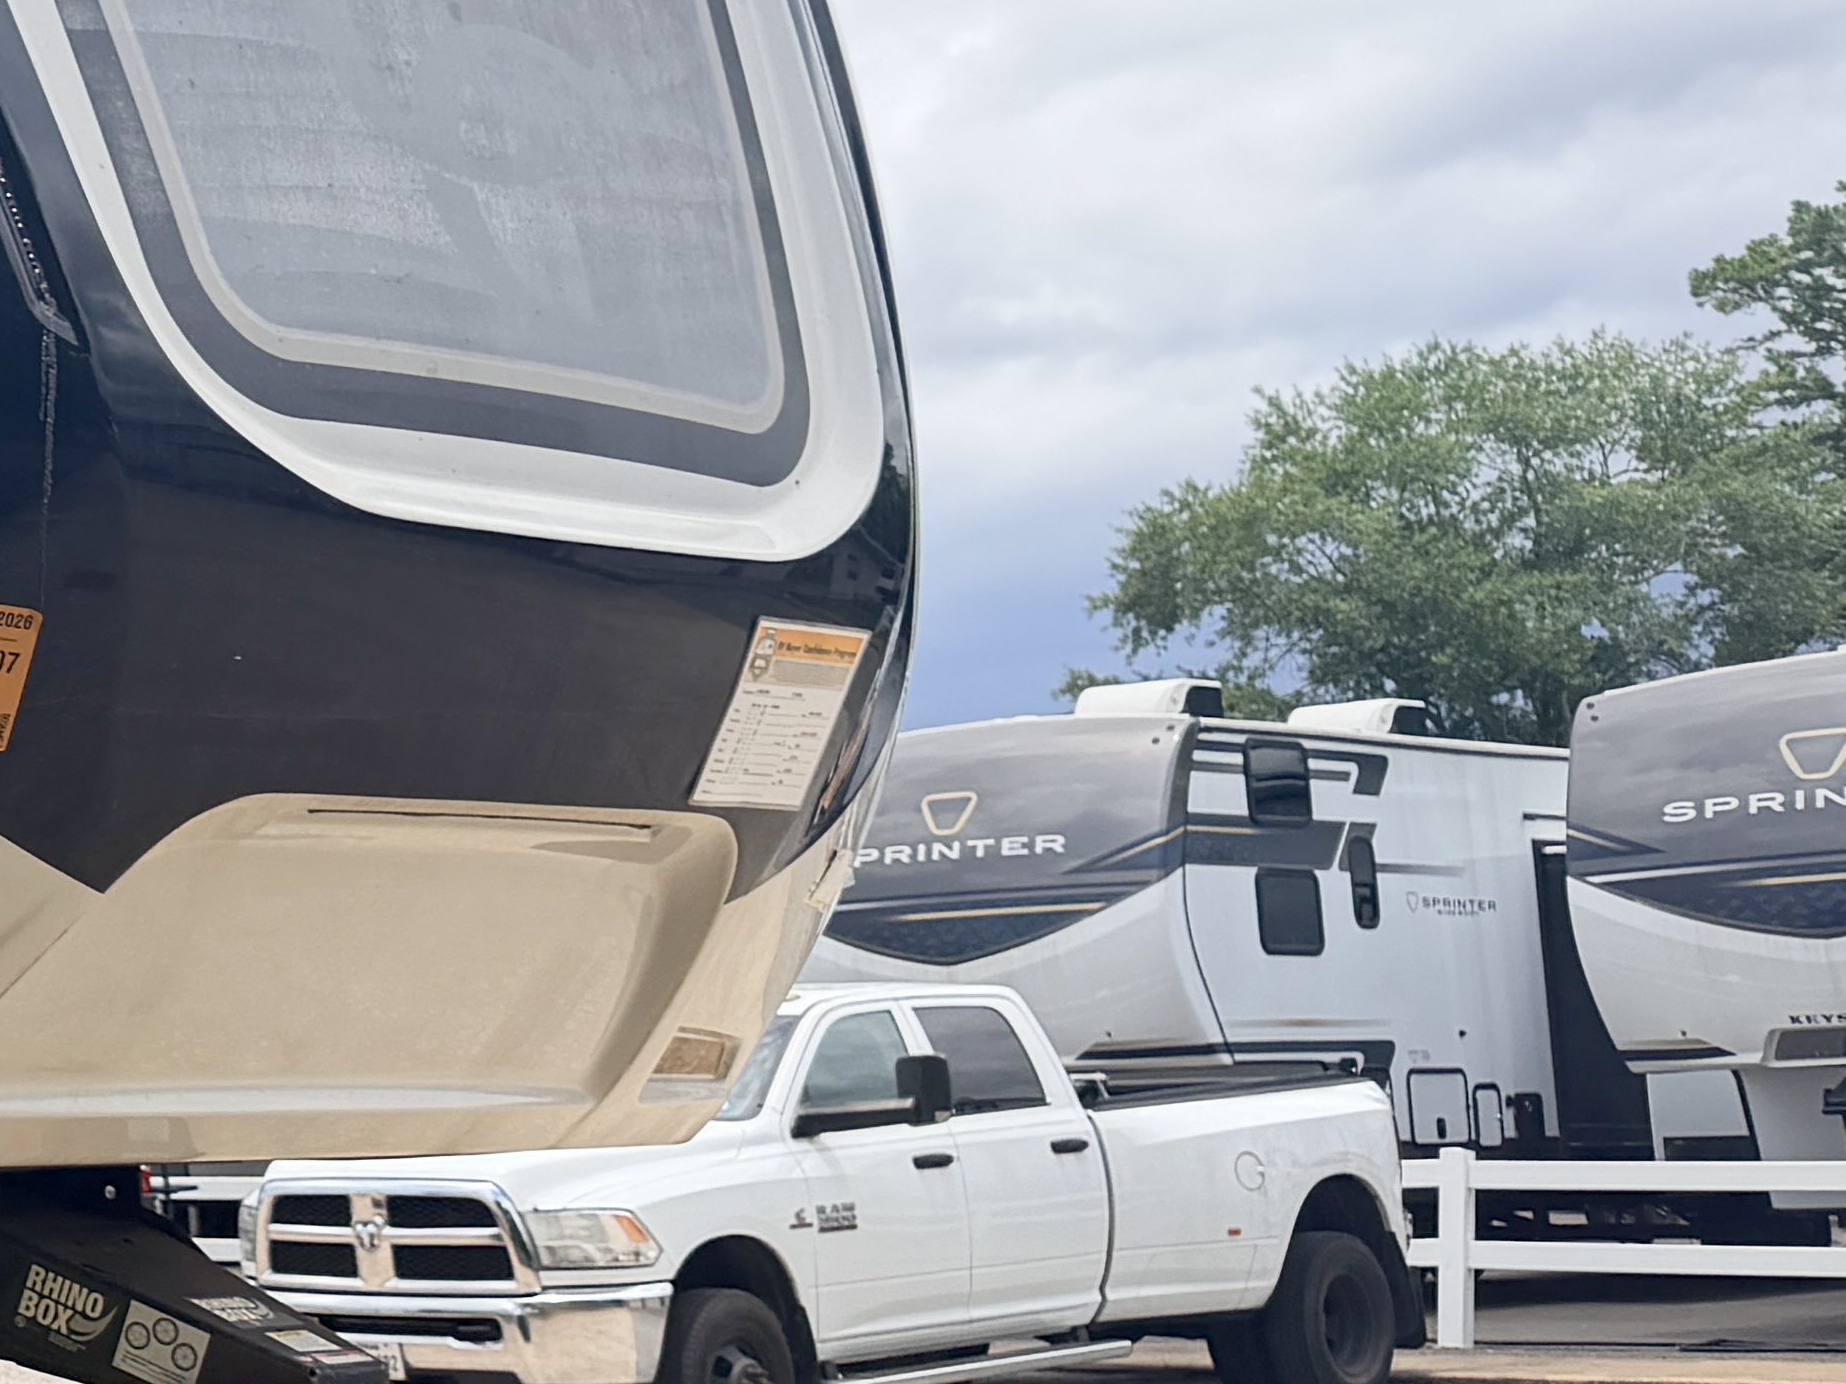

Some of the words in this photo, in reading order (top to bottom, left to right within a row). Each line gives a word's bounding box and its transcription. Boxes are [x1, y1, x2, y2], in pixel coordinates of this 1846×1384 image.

[1422, 896, 1497, 912] SPRINTER
[815, 1202, 855, 1214] RAM
[25, 1264, 106, 1319] RHINO
[18, 1288, 76, 1335] BOX
